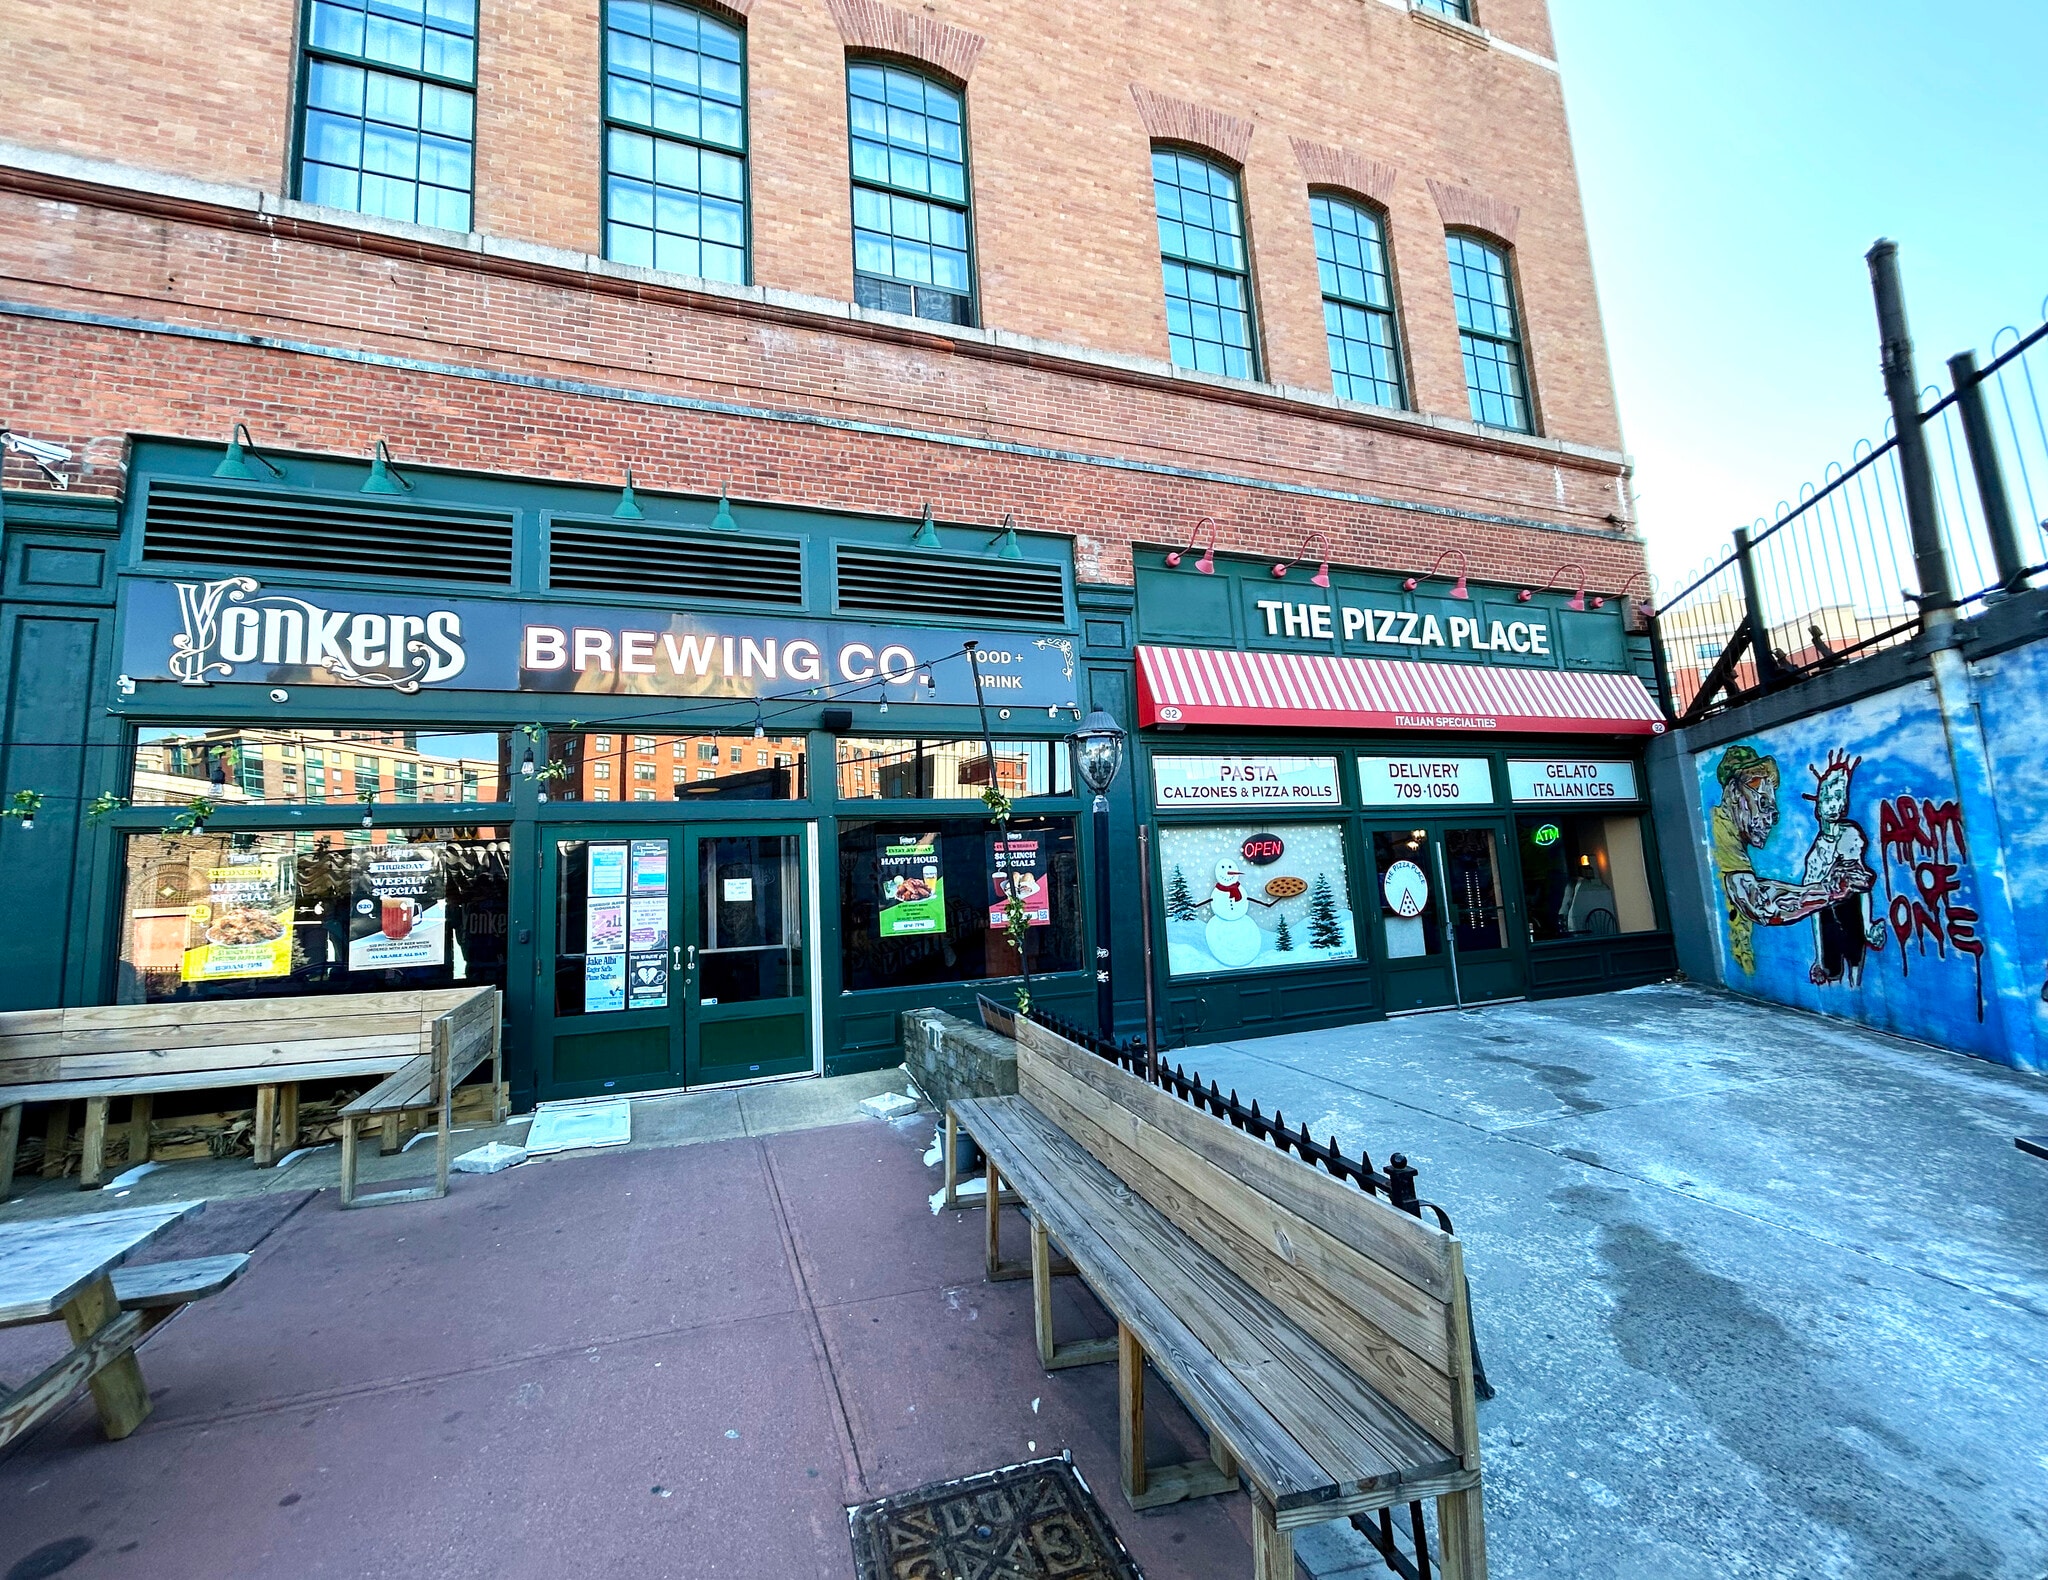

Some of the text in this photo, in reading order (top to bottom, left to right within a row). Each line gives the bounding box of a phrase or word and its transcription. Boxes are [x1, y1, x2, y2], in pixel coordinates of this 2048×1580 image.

[1257, 600, 1550, 654] THE PIZZA PLACE
[169, 576, 930, 693] Yonkers BREWING CO.
[1165, 708, 1177, 719] 92
[1395, 715, 1496, 728] ITALIAN SPECIALTIES
[1220, 765, 1278, 781] PASTA
[1389, 763, 1459, 778] DELIVERY
[1546, 764, 1597, 778] GELATO
[1163, 785, 1332, 799] CALZONES & PIZZA ROLLS
[1533, 783, 1615, 797] ITALIAN ICES
[1536, 828, 1559, 842] ATM
[1244, 840, 1281, 858] OPEN
[376, 863, 425, 871] THURSDAY
[881, 855, 938, 866] HAPPY HOUR
[995, 859, 1036, 868] SPCIALS
[210, 881, 274, 892] WEEKLY
[370, 875, 429, 886] WEEKLY
[1916, 862, 1961, 909] OF
[210, 891, 273, 902] SPECIAL
[371, 886, 428, 897] SPECIAL
[1890, 895, 1984, 958] ONE
